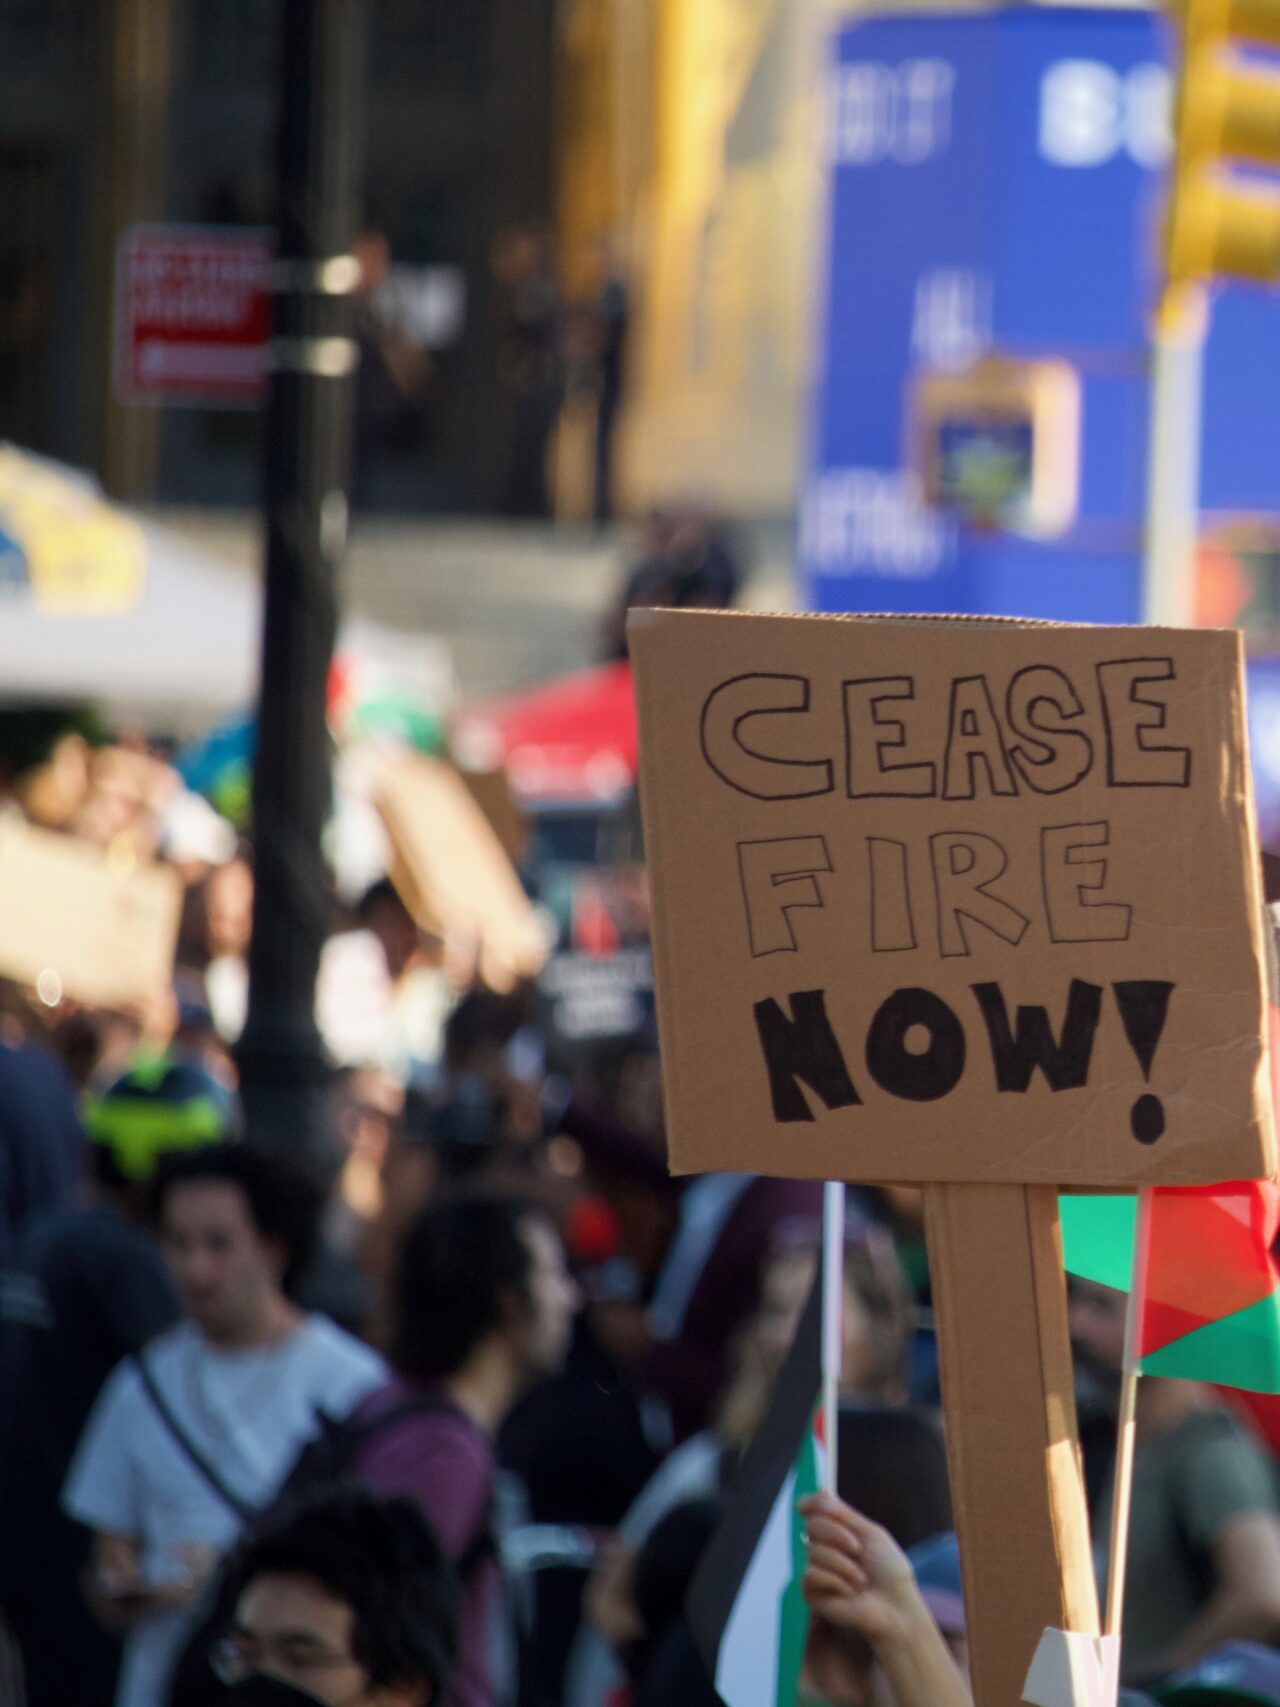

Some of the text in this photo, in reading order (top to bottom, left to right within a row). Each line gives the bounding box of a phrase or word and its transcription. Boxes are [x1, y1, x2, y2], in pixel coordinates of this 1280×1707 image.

[701, 657, 1191, 800] CEASE
[736, 820, 1132, 958] FIRE
[753, 977, 1177, 1145] NOW!
